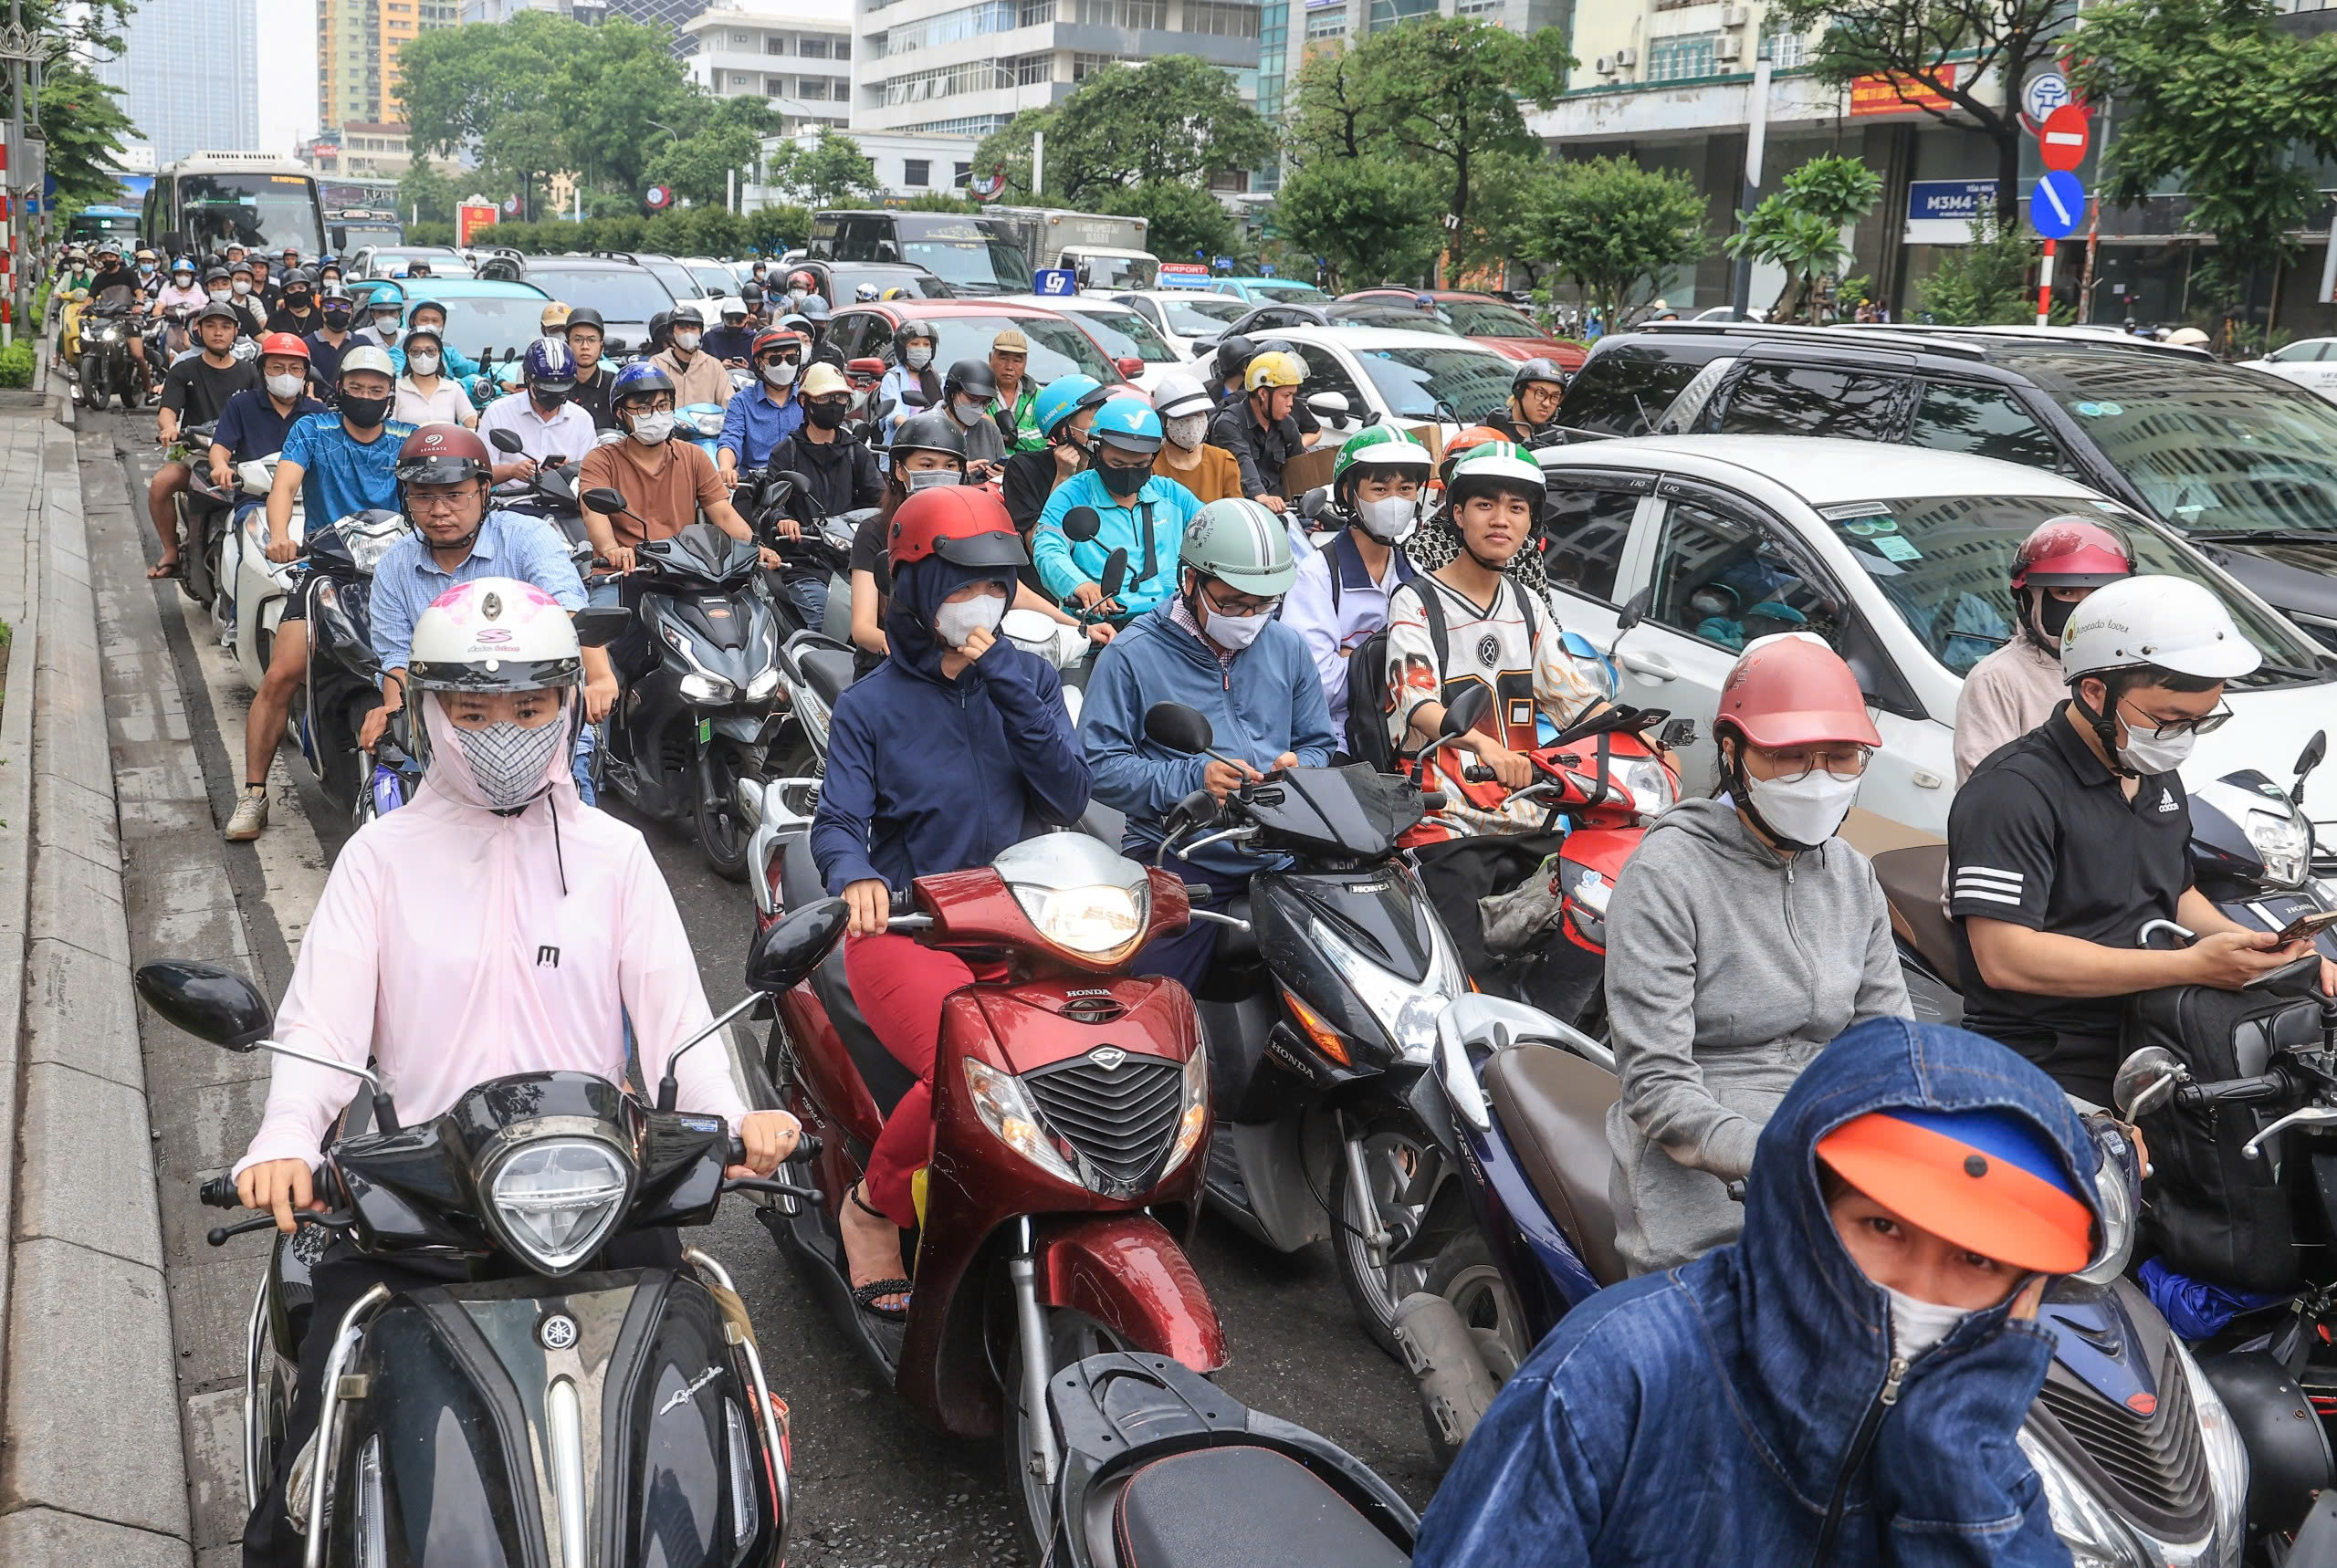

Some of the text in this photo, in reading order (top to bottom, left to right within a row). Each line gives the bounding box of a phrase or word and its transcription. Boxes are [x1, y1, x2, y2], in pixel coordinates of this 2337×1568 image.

[1163, 265, 1205, 273] AIRPORT
[1045, 272, 1066, 293] G7
[1042, 408, 1058, 425] XANH
[2076, 619, 2129, 636] Avocado lover
[2158, 802, 2180, 813] adidas
[1352, 883, 1390, 894] HONDA
[1066, 988, 1113, 998] HONDA
[1272, 1040, 1315, 1080] HONDA
[1451, 1113, 1485, 1187] VISION
